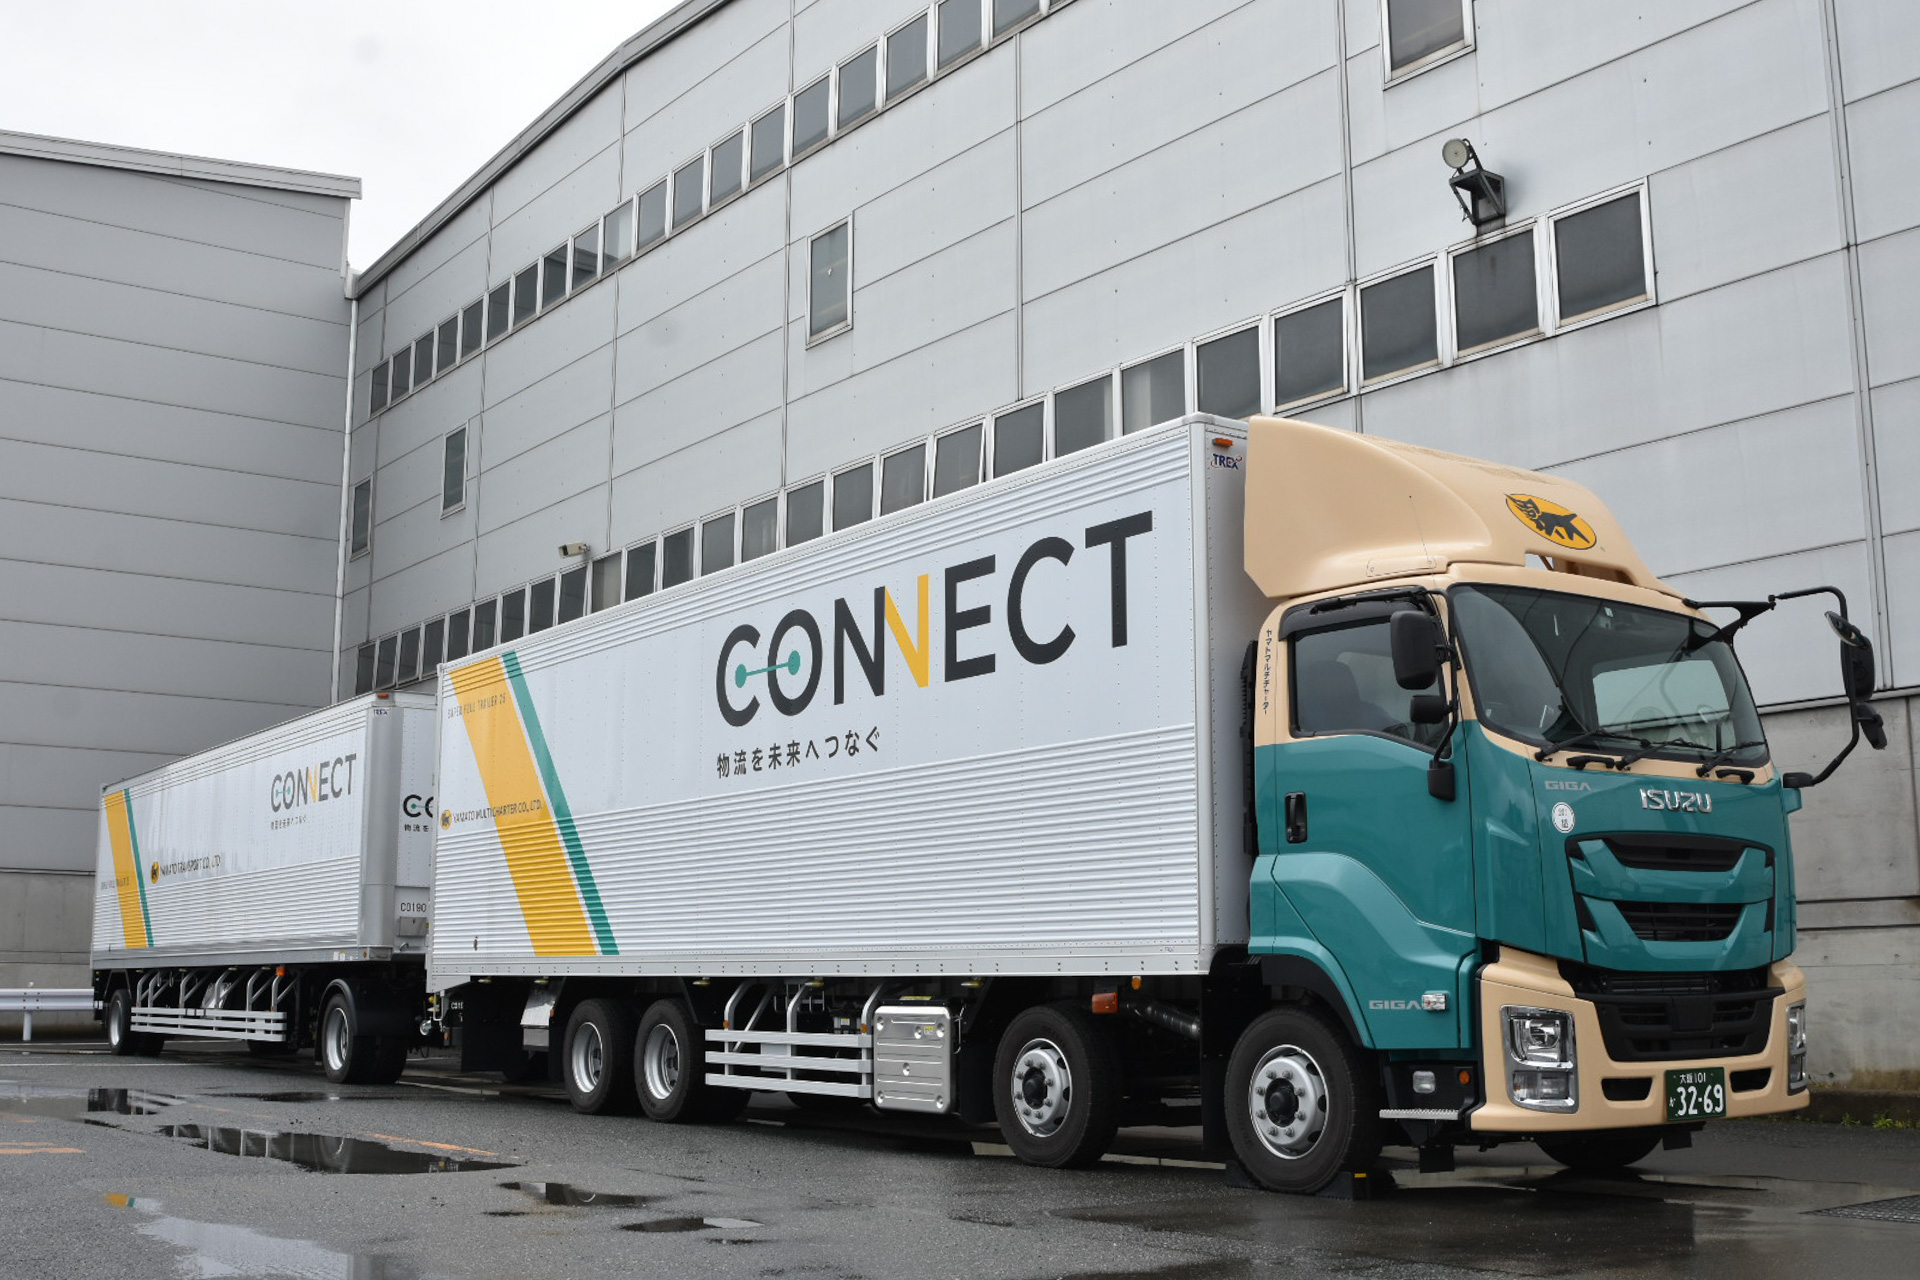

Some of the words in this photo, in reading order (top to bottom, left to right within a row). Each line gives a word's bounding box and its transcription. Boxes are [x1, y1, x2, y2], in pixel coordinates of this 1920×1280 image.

[1212, 453, 1240, 469] TREX
[716, 510, 1153, 727] CONNECT
[1263, 629, 1272, 715] ヤマトマルチチャーター
[716, 726, 880, 778] 物流を未来へつなぐ
[271, 753, 357, 813] CONNECT
[1544, 780, 1592, 791] GIGA
[1639, 787, 1713, 813] ISUZU
[453, 810, 475, 823] YAMATO
[1369, 999, 1422, 1010] GIGA
[1676, 1084, 1724, 1116] 32-69
